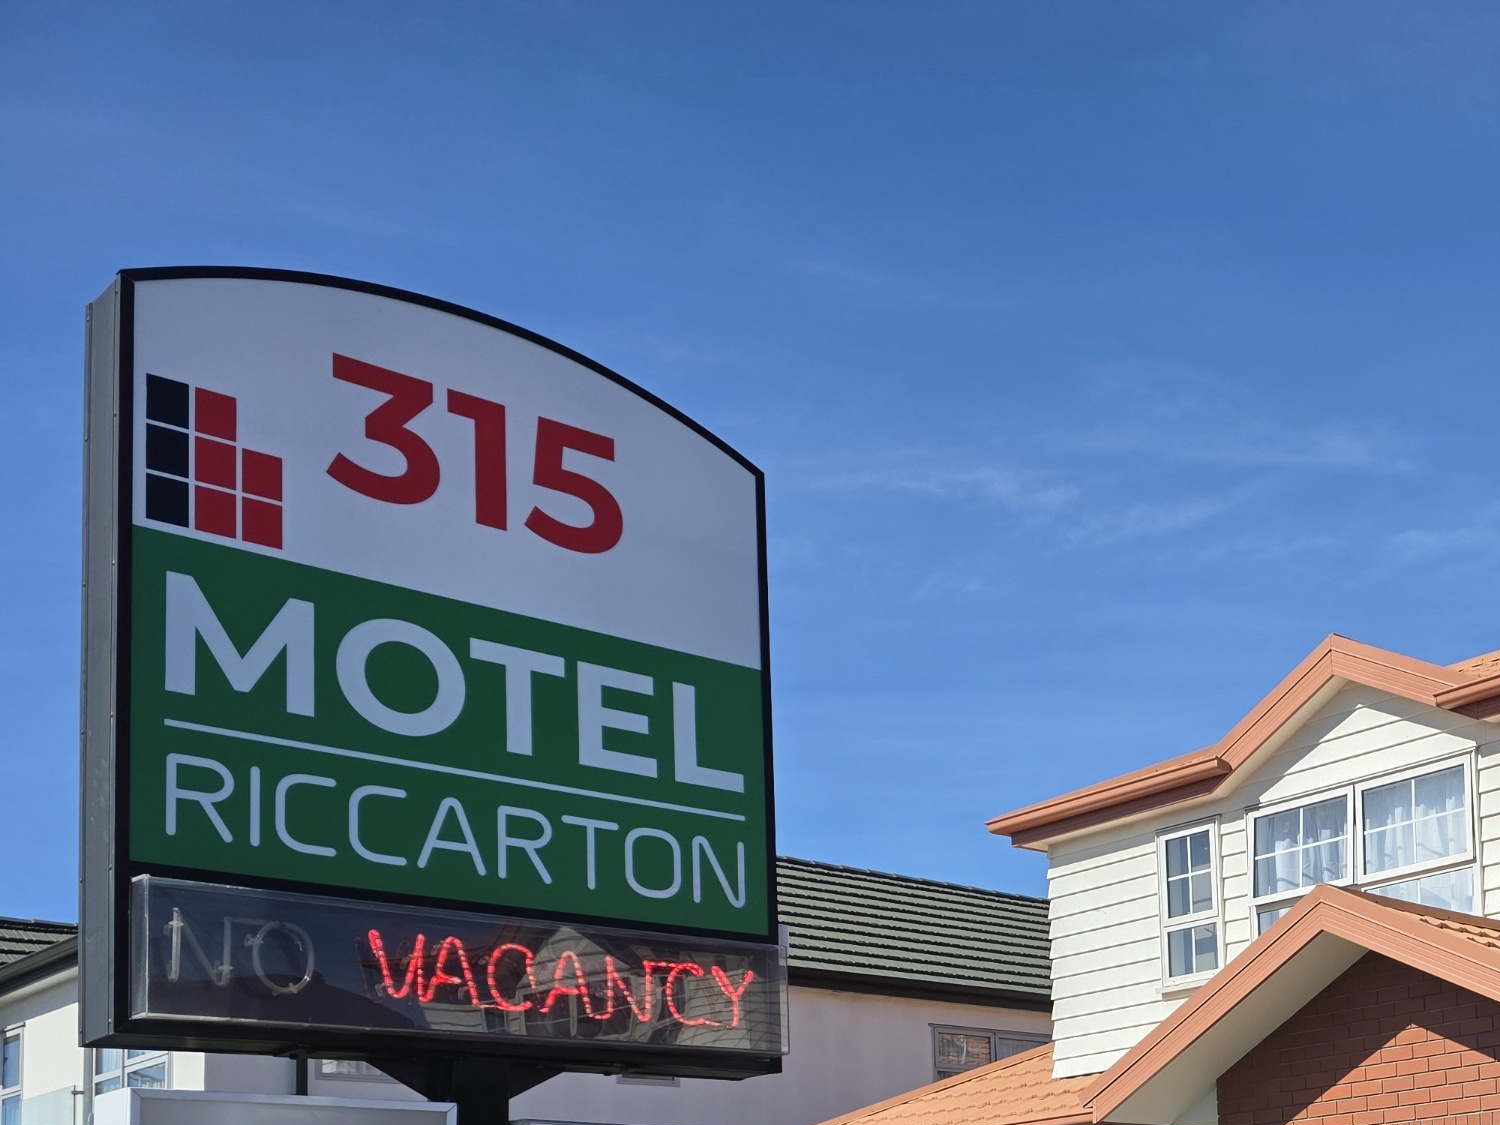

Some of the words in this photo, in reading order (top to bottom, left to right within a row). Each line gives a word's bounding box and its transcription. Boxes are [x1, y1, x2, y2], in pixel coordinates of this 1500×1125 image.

[325, 352, 624, 554] 315
[165, 571, 745, 793] MOTEL
[165, 752, 746, 909] RICCARTON
[168, 907, 315, 997] NO
[368, 927, 753, 1029] VACANCY
